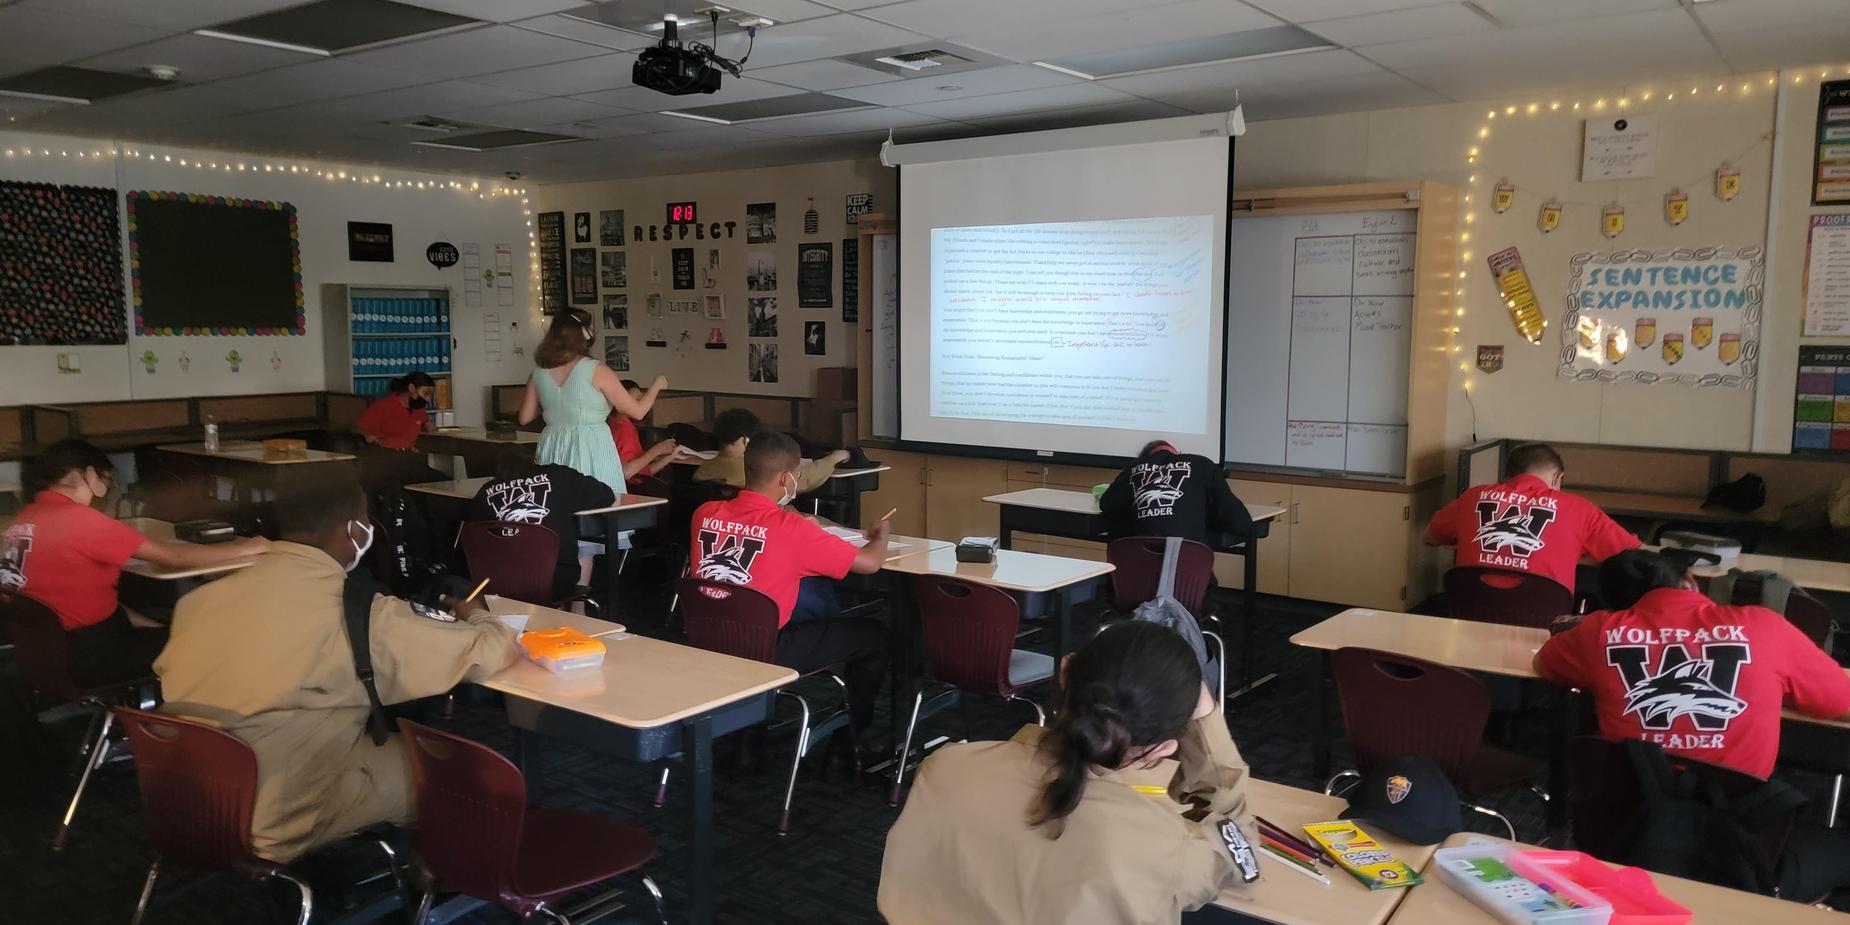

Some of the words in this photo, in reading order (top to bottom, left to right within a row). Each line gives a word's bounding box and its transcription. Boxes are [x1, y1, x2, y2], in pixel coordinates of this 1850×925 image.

[847, 195, 869, 206] KEEP
[847, 205, 869, 214] CALM
[634, 221, 737, 242] RESPECT
[429, 252, 458, 262] VIBES
[802, 248, 829, 263] INTEGRITY
[1586, 264, 1738, 286] SENTENCE
[1579, 288, 1745, 310] EXPANSION
[1131, 461, 1191, 474] WOLFPACK
[485, 473, 550, 496] WOLFPACK
[1480, 489, 1558, 510] WOLFPACK
[1137, 507, 1174, 519] LEADER
[702, 516, 769, 540] WOLFPACK
[1479, 554, 1529, 570] LEADER
[1605, 625, 1750, 646] WOLFPACK
